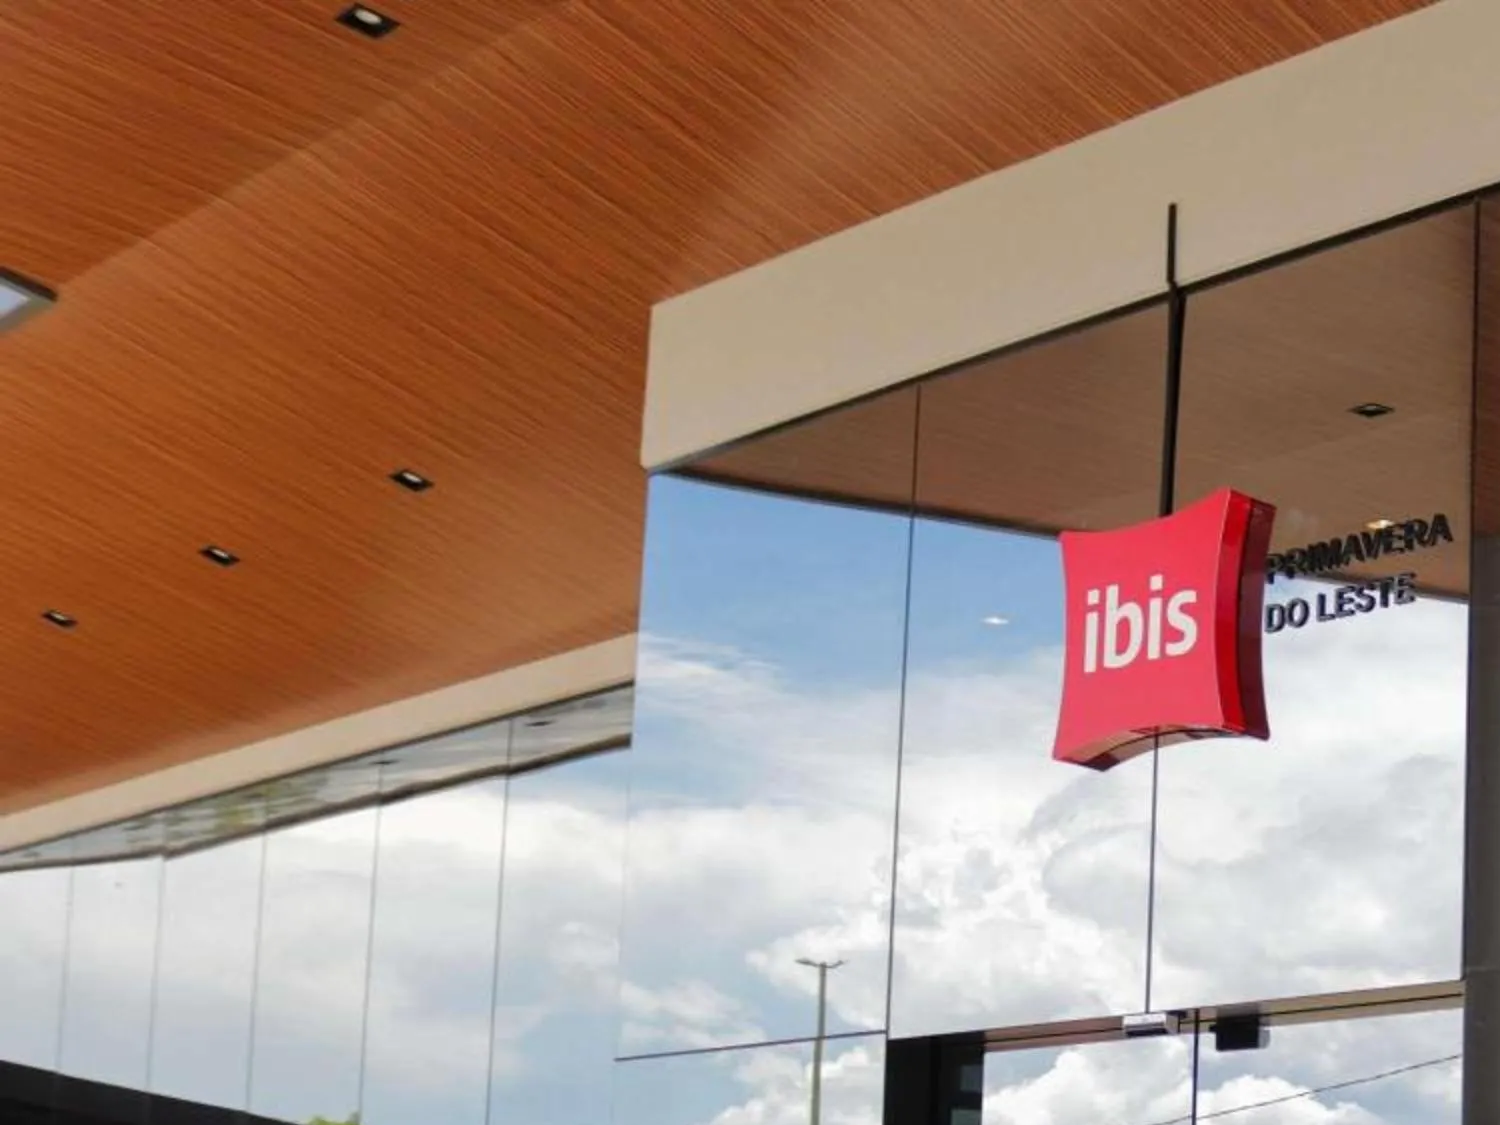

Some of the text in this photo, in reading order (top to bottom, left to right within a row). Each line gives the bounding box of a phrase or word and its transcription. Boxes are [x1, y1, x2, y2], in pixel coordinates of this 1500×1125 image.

[1266, 513, 1453, 584] PRIMAVERA
[1083, 574, 1198, 673] ibis
[1265, 571, 1417, 634] DO LESTE
